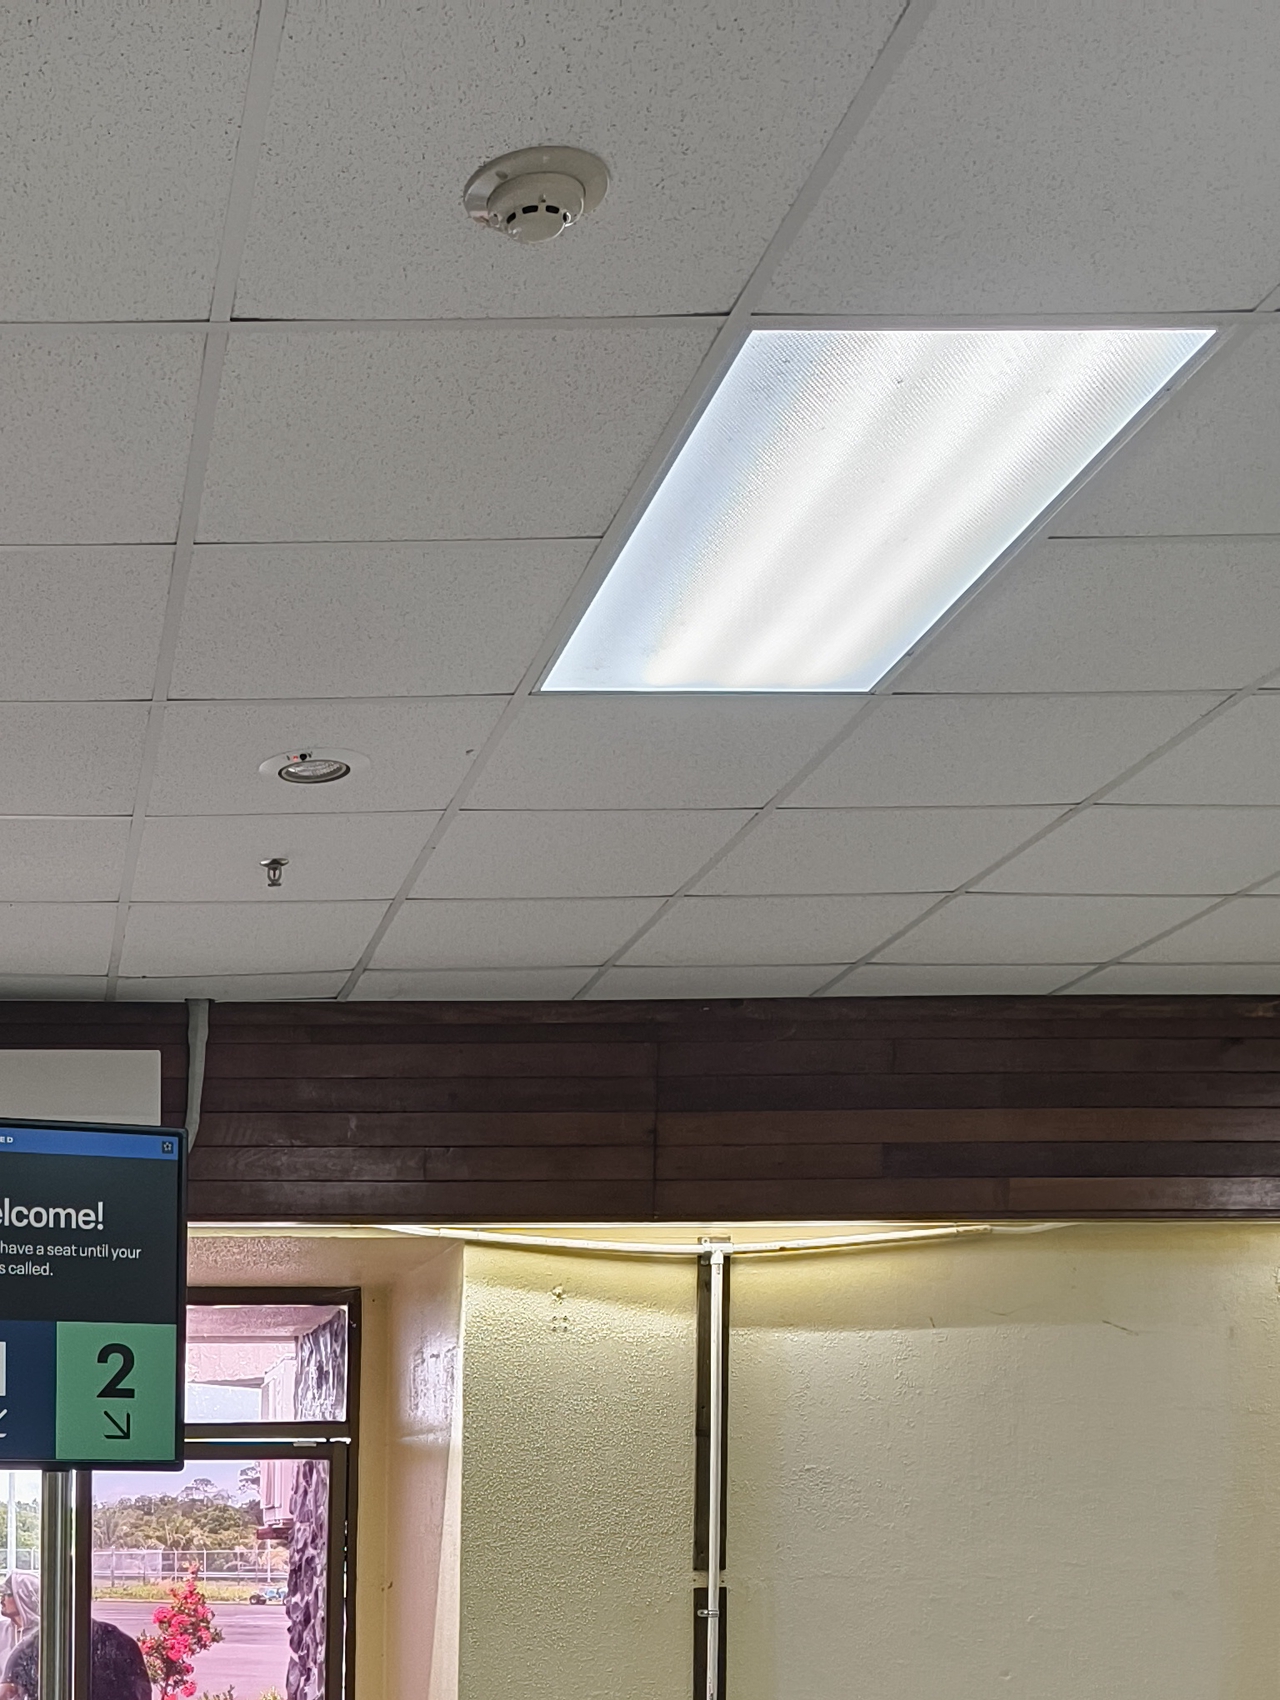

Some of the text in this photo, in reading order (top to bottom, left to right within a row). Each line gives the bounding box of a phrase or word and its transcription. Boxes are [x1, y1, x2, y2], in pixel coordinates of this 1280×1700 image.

[0, 1240, 34, 1256] have
[36, 1245, 45, 1256] a
[47, 1244, 78, 1257] seat
[79, 1244, 109, 1259] until
[111, 1247, 142, 1262] your
[8, 1261, 54, 1276] called.
[96, 1342, 135, 1399] 2
